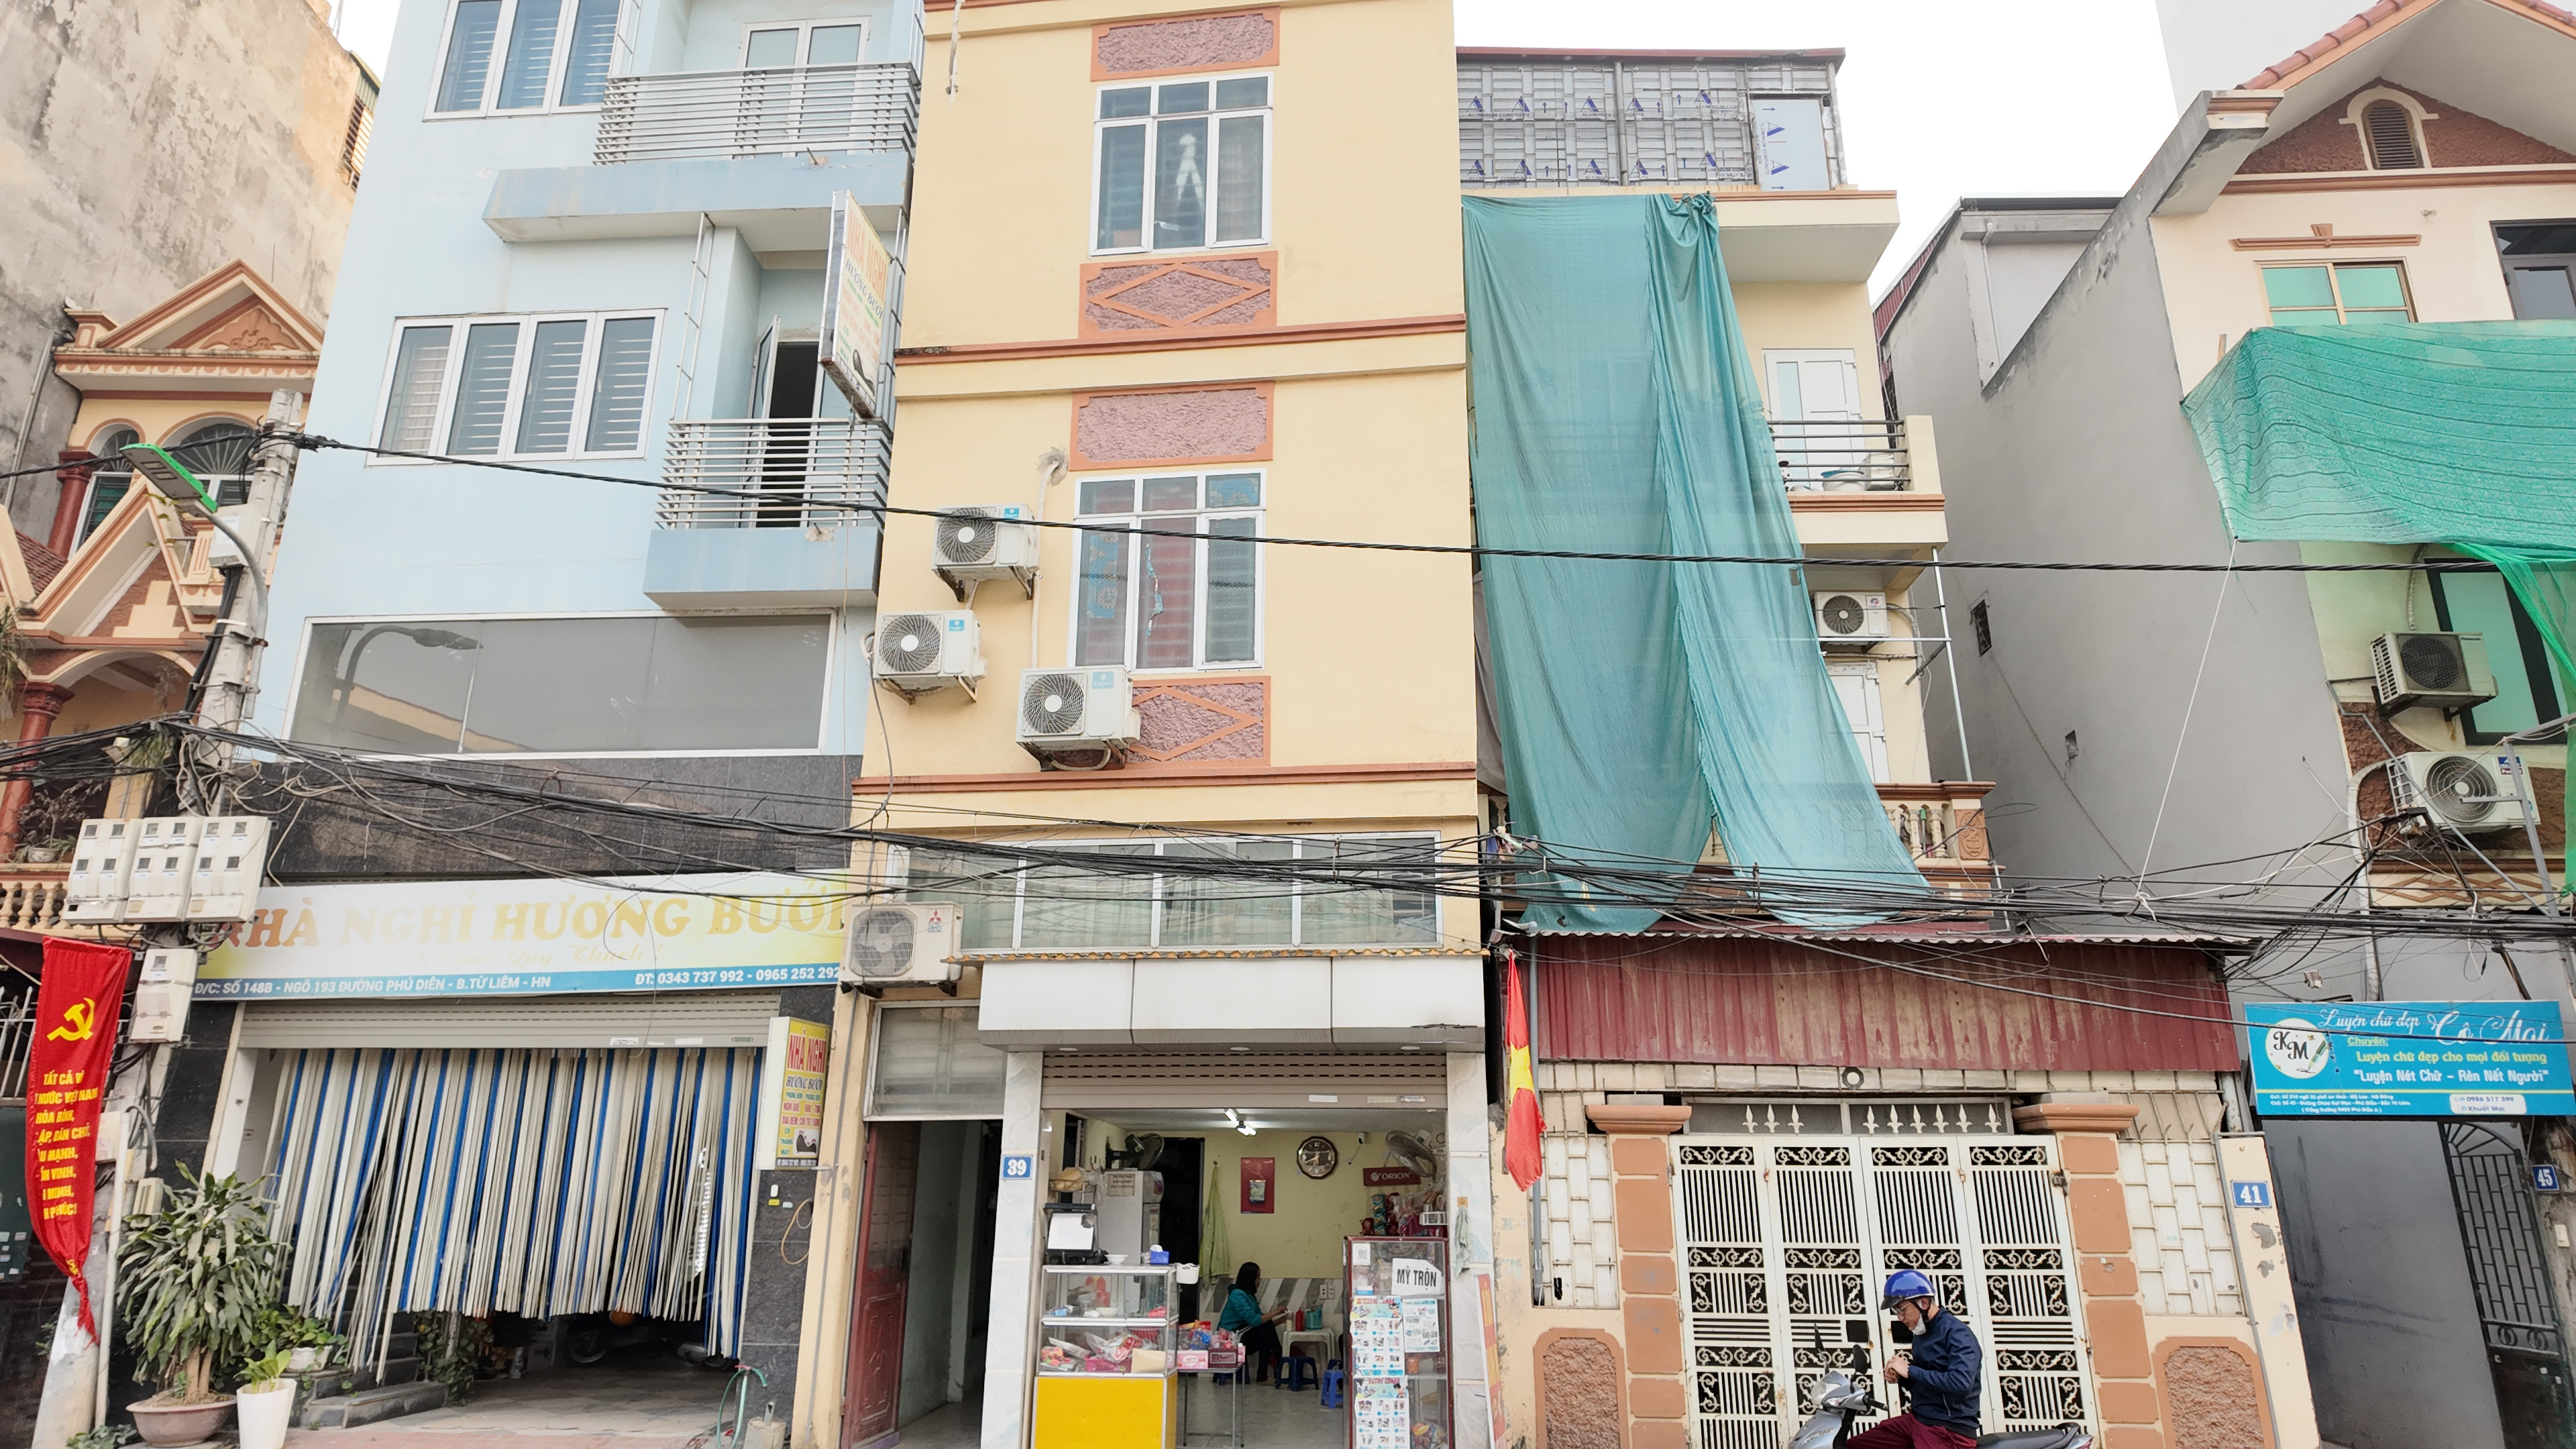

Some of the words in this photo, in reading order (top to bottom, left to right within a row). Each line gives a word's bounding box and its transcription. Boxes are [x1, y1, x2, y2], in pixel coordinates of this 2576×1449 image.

[339, 890, 477, 946] NGHỈ
[489, 892, 691, 941] HƯƠNG
[195, 982, 220, 994] Đ/C:
[222, 979, 243, 994] SỐ
[244, 982, 274, 994] 148B
[314, 981, 336, 993] 193
[337, 977, 384, 993] ĐƯỜNG
[488, 975, 521, 989] LIÊM
[531, 976, 551, 987] HN
[635, 974, 654, 985] ĐT:
[657, 972, 690, 985] 0343
[692, 971, 717, 984] 737
[720, 970, 744, 983] 992
[755, 968, 788, 981] 0965
[790, 967, 815, 980] 252
[817, 967, 840, 979] 292
[2427, 1010, 2474, 1045] Cô
[787, 1028, 806, 1071] NHÀ
[2347, 1036, 2389, 1047] Chuyên:
[2356, 1051, 2390, 1065] Luyện
[2393, 1051, 2415, 1062] chữ
[2418, 1051, 2439, 1065] đẹp
[2442, 1051, 2464, 1062] cho
[2466, 1051, 2489, 1065] mọi
[2491, 1049, 2510, 1063] đối
[44, 1069, 58, 1085] TẤT
[59, 1069, 73, 1085] CẢ
[2396, 1069, 2417, 1082] Nét
[2458, 1069, 2481, 1082] Rèn
[1008, 1159, 1027, 1176] 39
[1381, 1172, 1409, 1180] ORION
[2538, 1169, 2553, 1187] 45
[2241, 1185, 2262, 1203] 41
